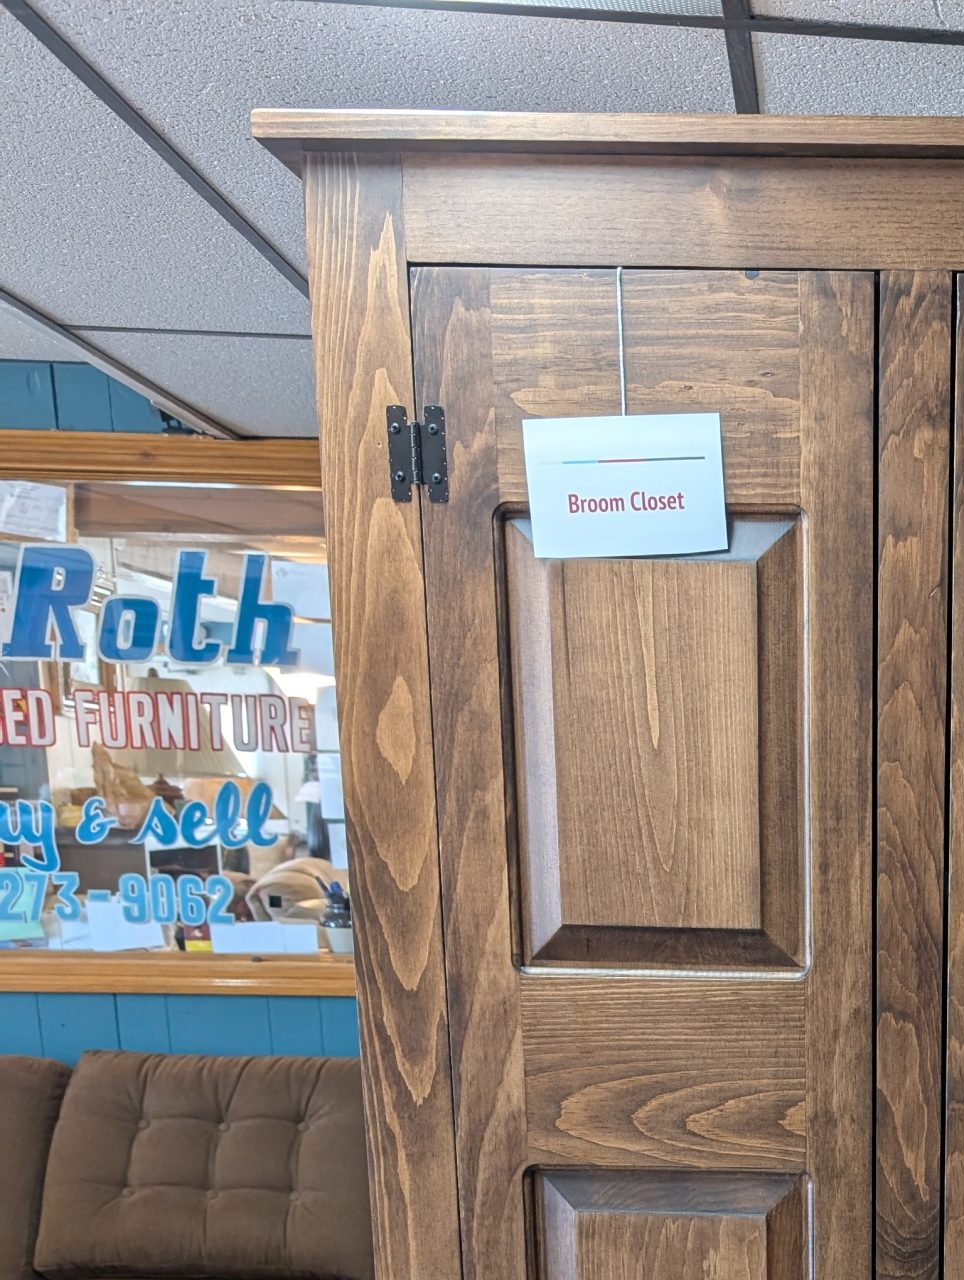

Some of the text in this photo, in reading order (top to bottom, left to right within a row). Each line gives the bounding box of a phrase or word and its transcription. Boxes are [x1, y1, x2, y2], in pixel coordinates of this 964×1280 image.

[568, 491, 685, 514] Broom Closet
[1, 541, 301, 667] Roth
[0, 687, 315, 754] ED FURNITURE
[75, 796, 118, 845] &
[128, 780, 279, 849] sell
[0, 871, 236, 926] 273-9062
